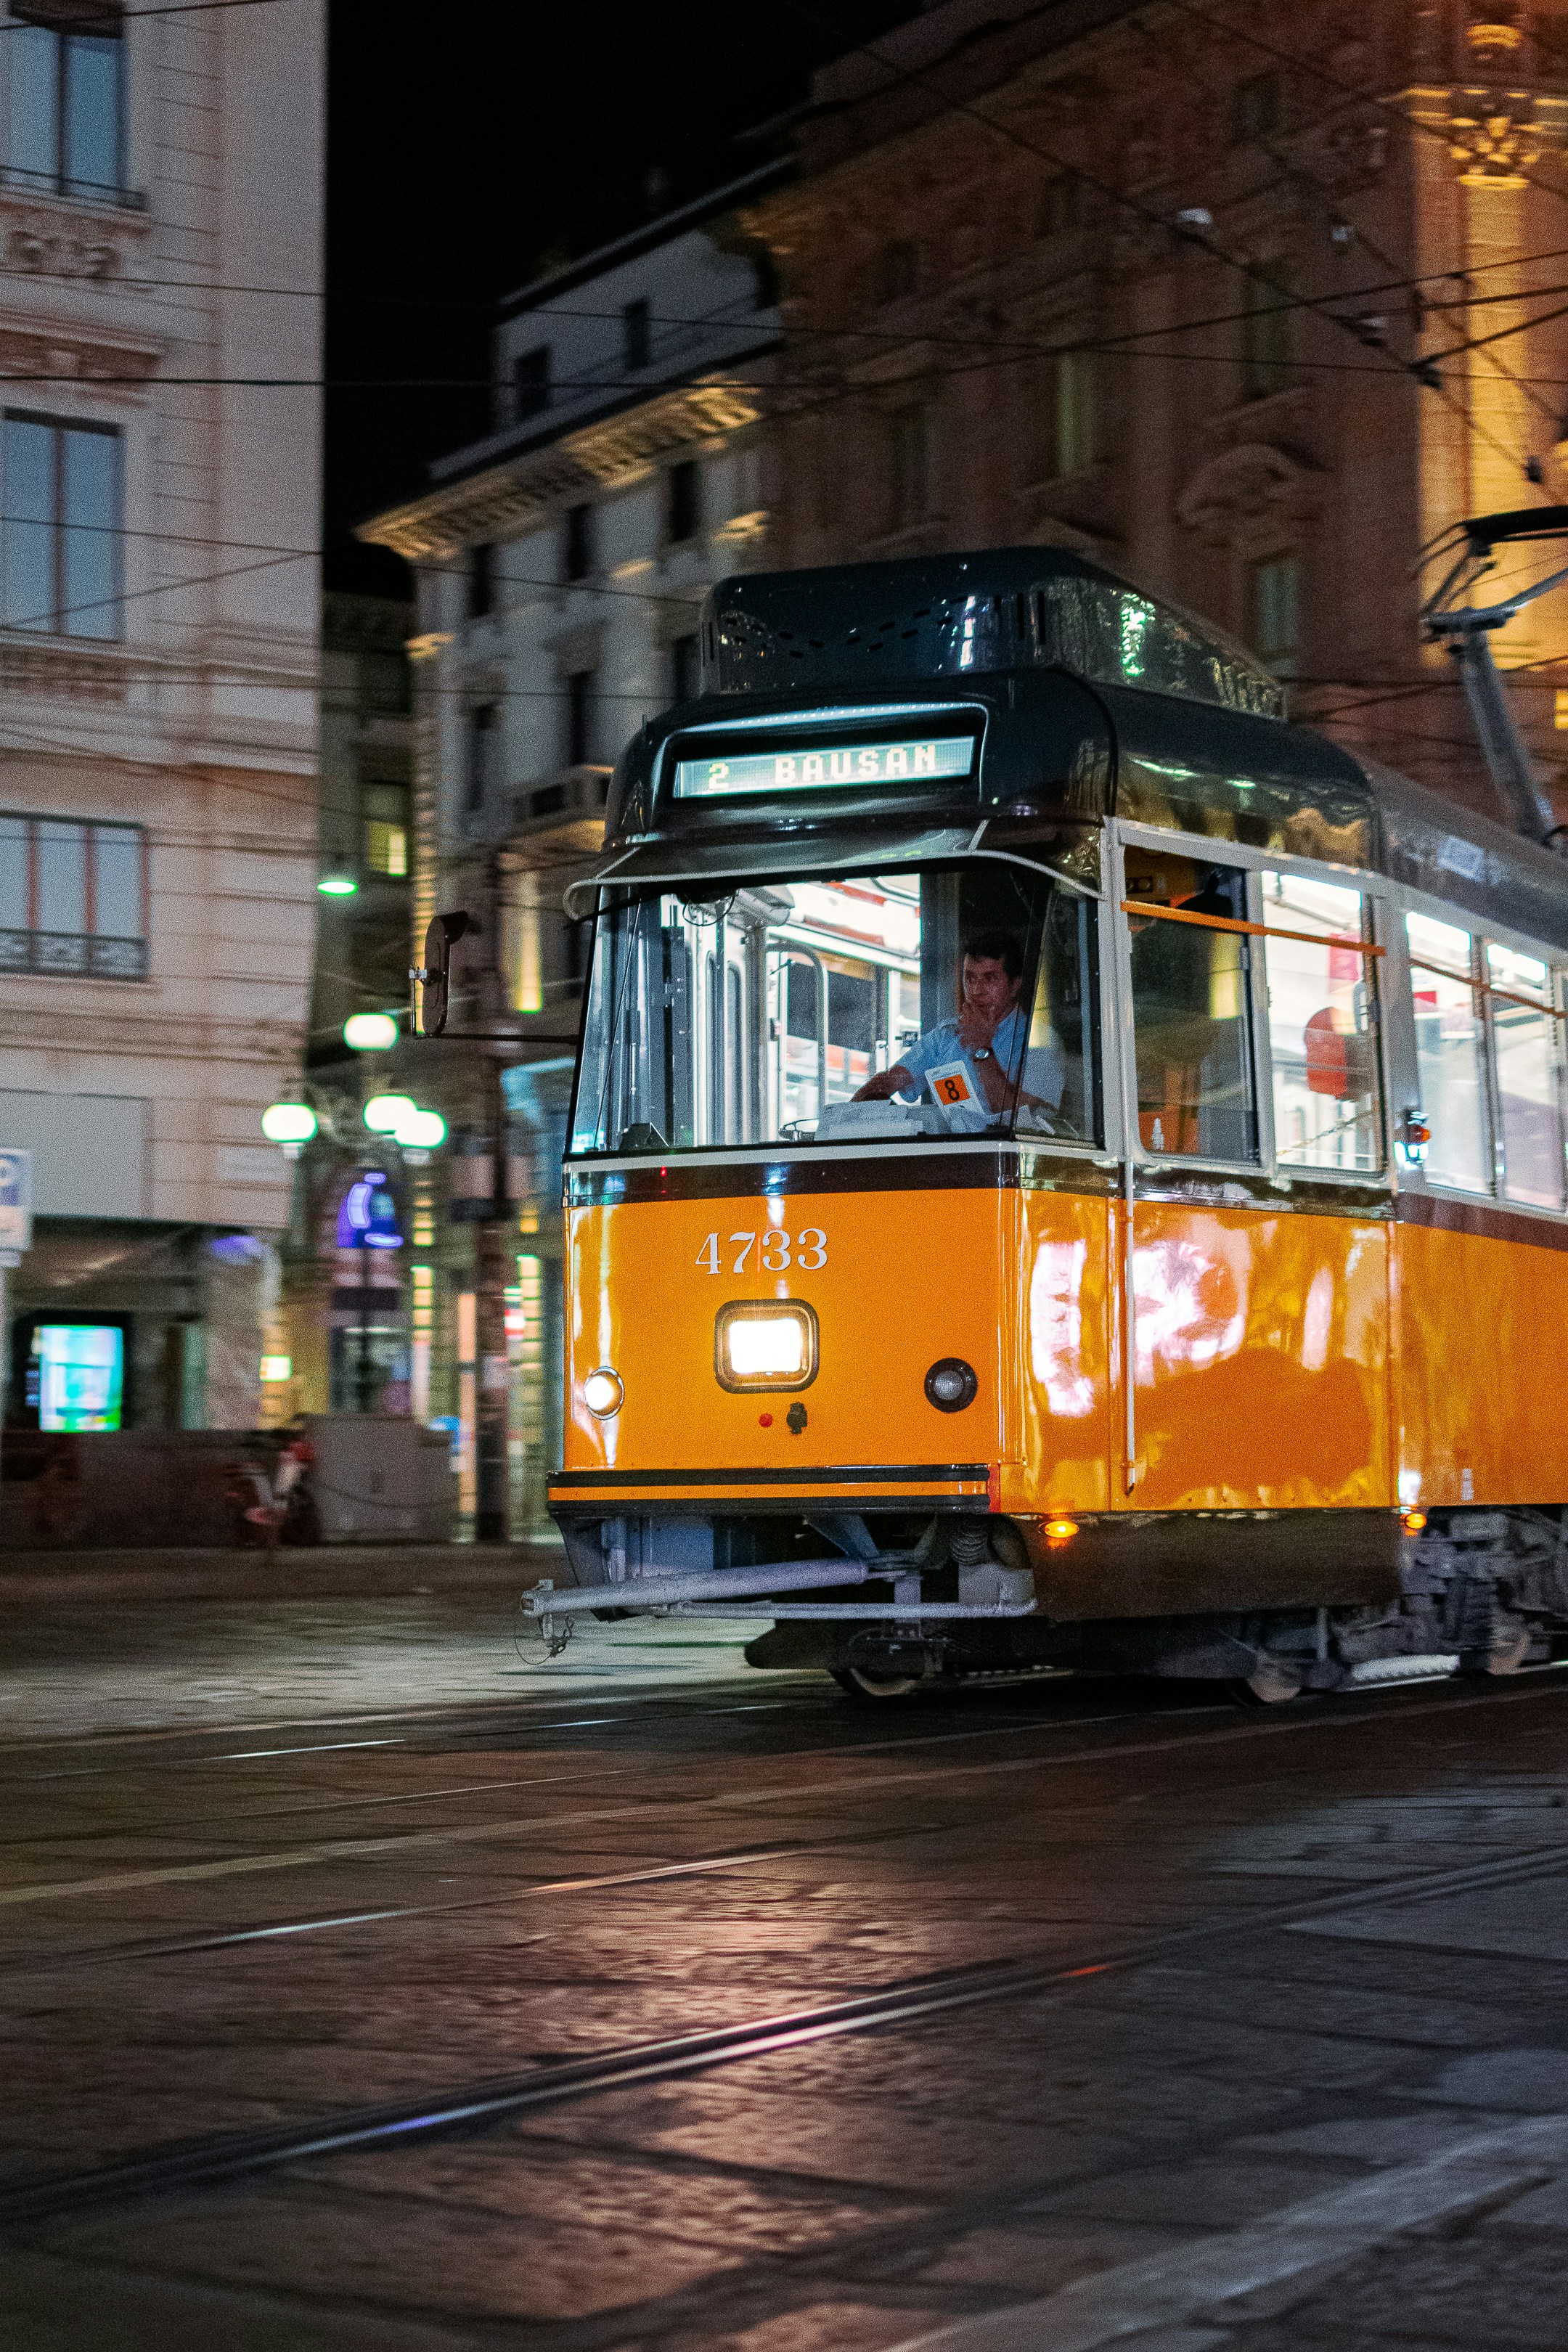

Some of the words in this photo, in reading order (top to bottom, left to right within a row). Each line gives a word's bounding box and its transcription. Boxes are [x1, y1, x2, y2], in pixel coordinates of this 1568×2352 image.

[708, 763, 730, 791] 2
[775, 745, 936, 785] BAUSAN
[944, 1079, 960, 1101] 8
[695, 1228, 828, 1275] 4733
